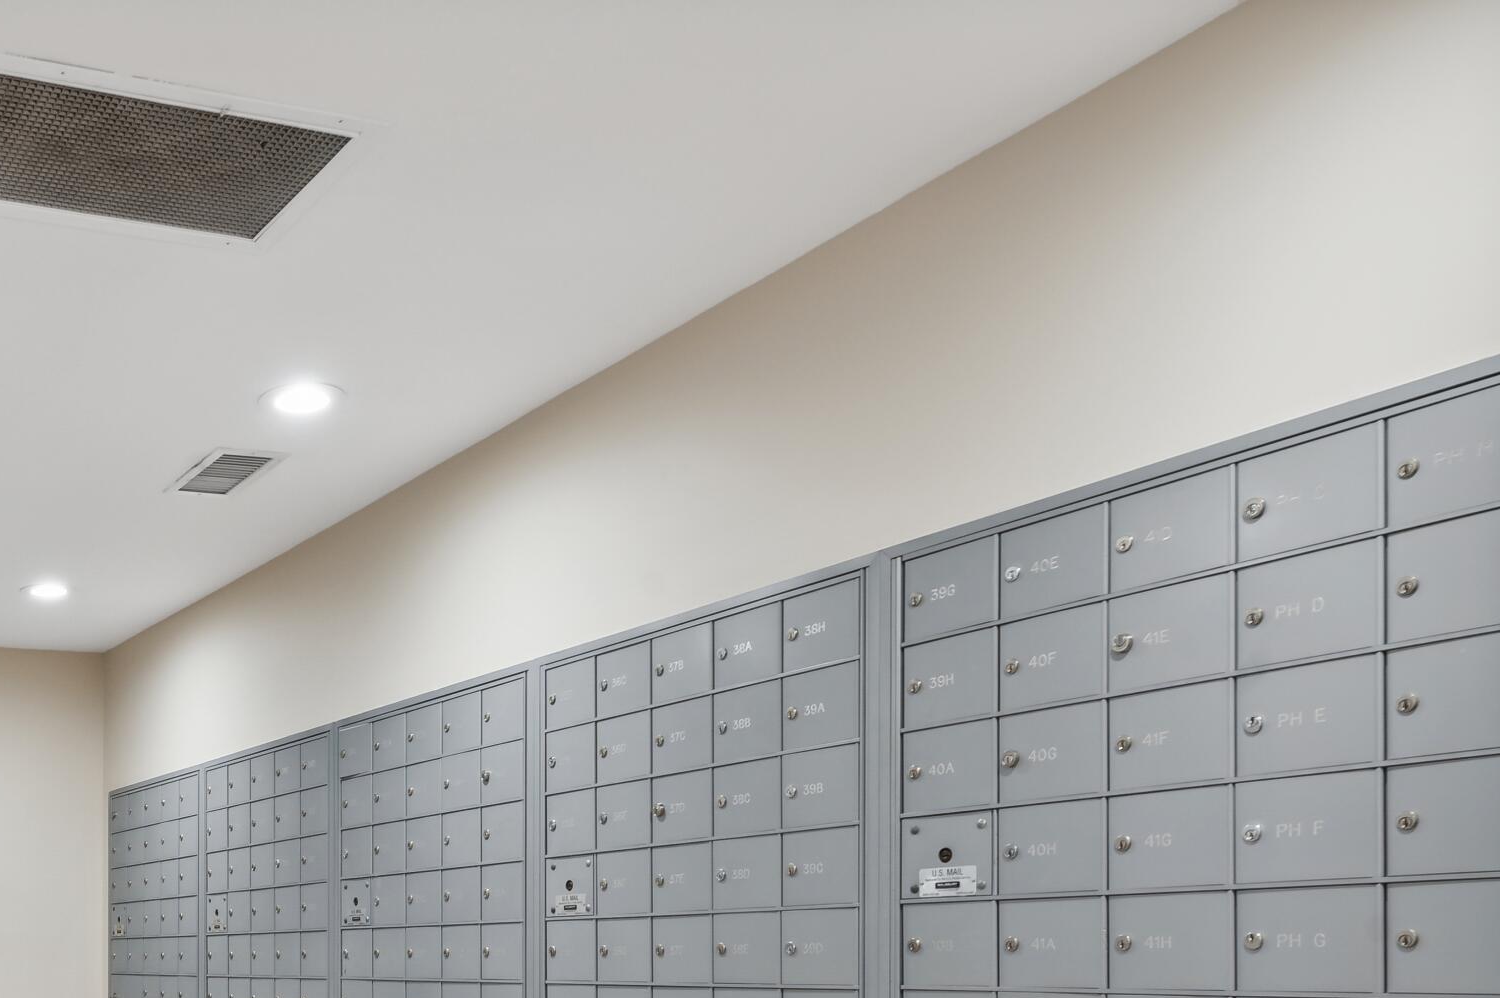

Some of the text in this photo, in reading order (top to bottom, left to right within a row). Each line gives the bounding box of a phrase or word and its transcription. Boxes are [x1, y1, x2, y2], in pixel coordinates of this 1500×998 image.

[1030, 556, 1061, 574] 40E
[930, 584, 956, 601] 39G
[1275, 596, 1325, 618] PH D
[804, 621, 826, 637] 38H
[1141, 629, 1171, 645] 41E
[732, 640, 753, 655] 38A
[1028, 651, 1058, 668] 40F
[929, 673, 955, 689] 39H
[803, 702, 825, 717] 39A
[1276, 707, 1327, 728] PH E
[1141, 730, 1170, 747] 41F
[1027, 747, 1058, 763] 40G
[928, 762, 955, 776] 40A
[803, 782, 824, 796] 39B
[1275, 819, 1325, 838] PH F
[1143, 833, 1173, 848] 41G
[1027, 842, 1058, 857] 40H
[946, 868, 963, 876] MAIL
[1030, 937, 1056, 951] 41A
[1276, 932, 1327, 948] PH G
